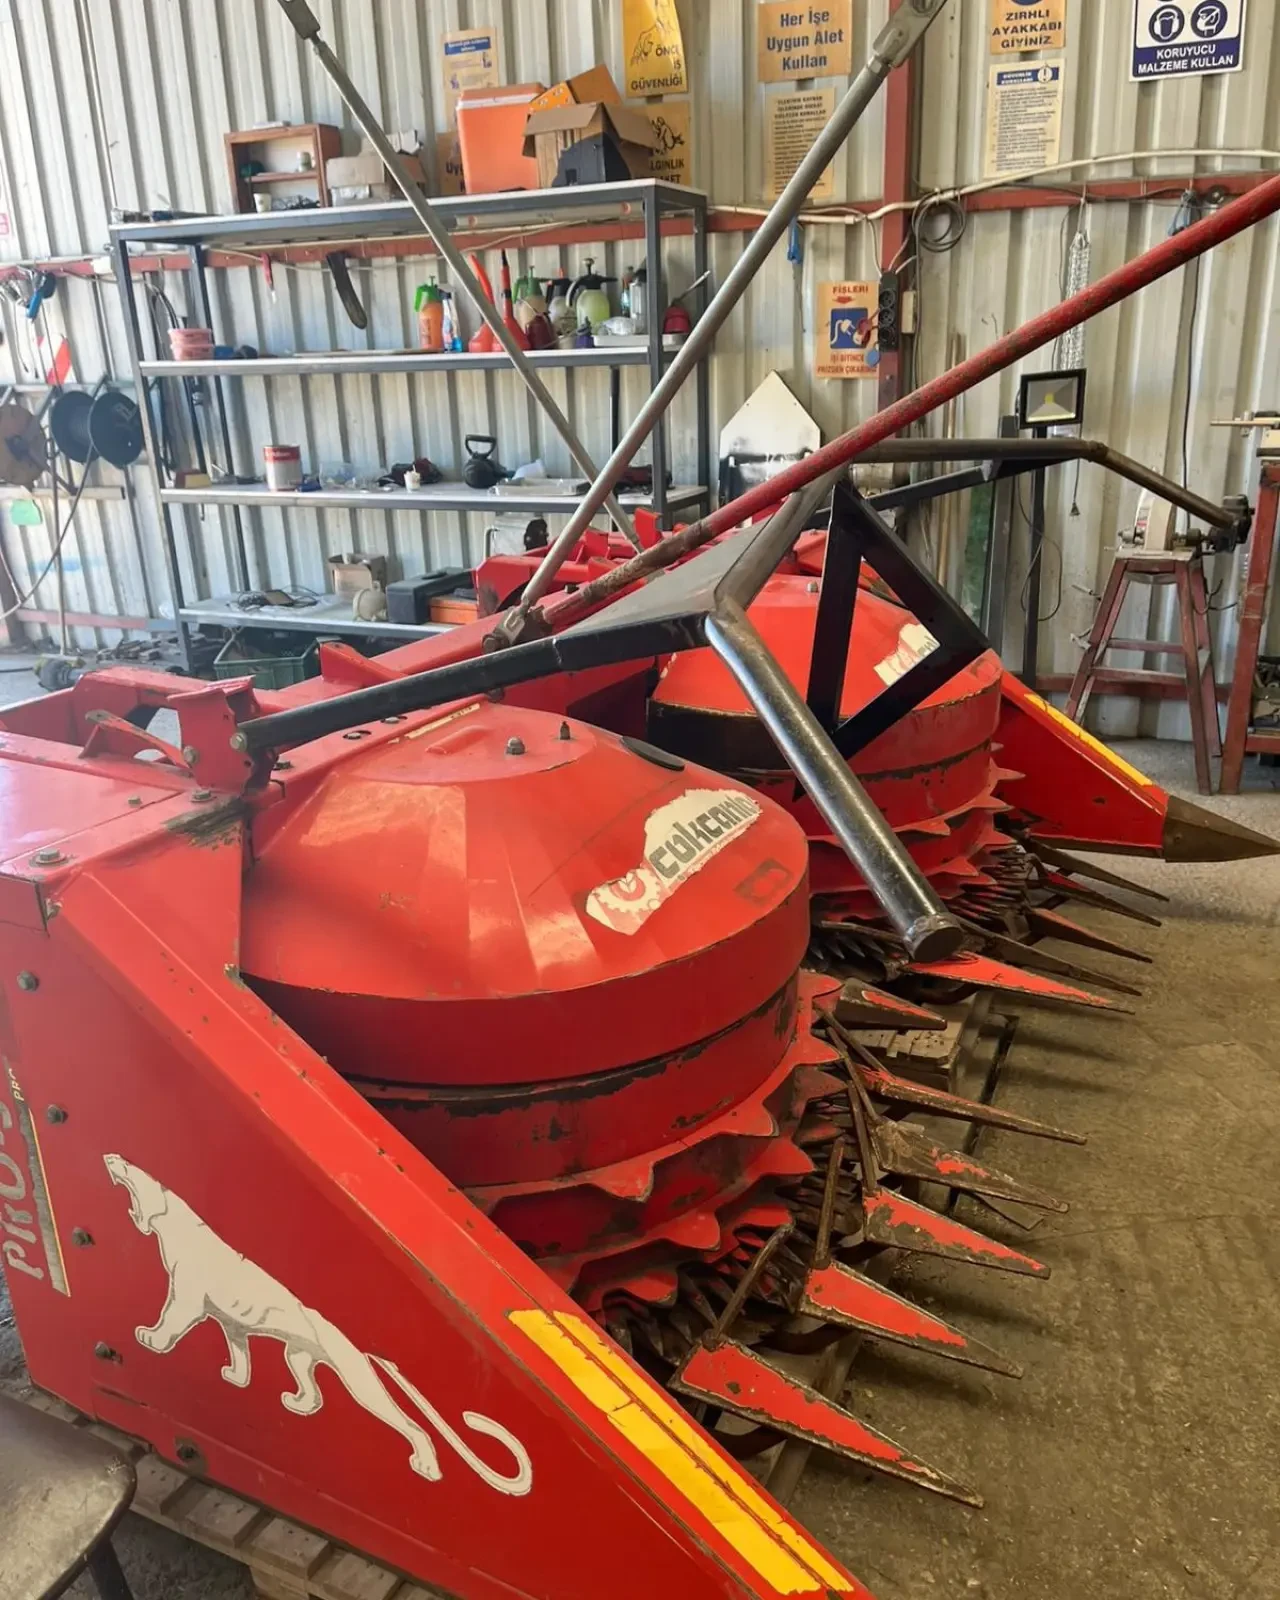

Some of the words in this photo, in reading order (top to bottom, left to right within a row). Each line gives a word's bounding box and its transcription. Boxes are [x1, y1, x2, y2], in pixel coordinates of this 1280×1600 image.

[780, 13, 804, 28] Her
[809, 6, 830, 25] İşe
[1005, 9, 1050, 21] ZIRHLI
[992, 21, 1062, 36] AYAKKABI
[767, 35, 809, 52] Uygun
[814, 28, 844, 46] Alet
[1001, 35, 1053, 49] GİYİNİZ
[1156, 44, 1216, 60] KORUYUCU
[782, 54, 827, 71] Kullan
[1138, 60, 1188, 74] MALZEME
[1191, 55, 1233, 68] KULLAN
[631, 73, 683, 91] GÜVENLİĞİ
